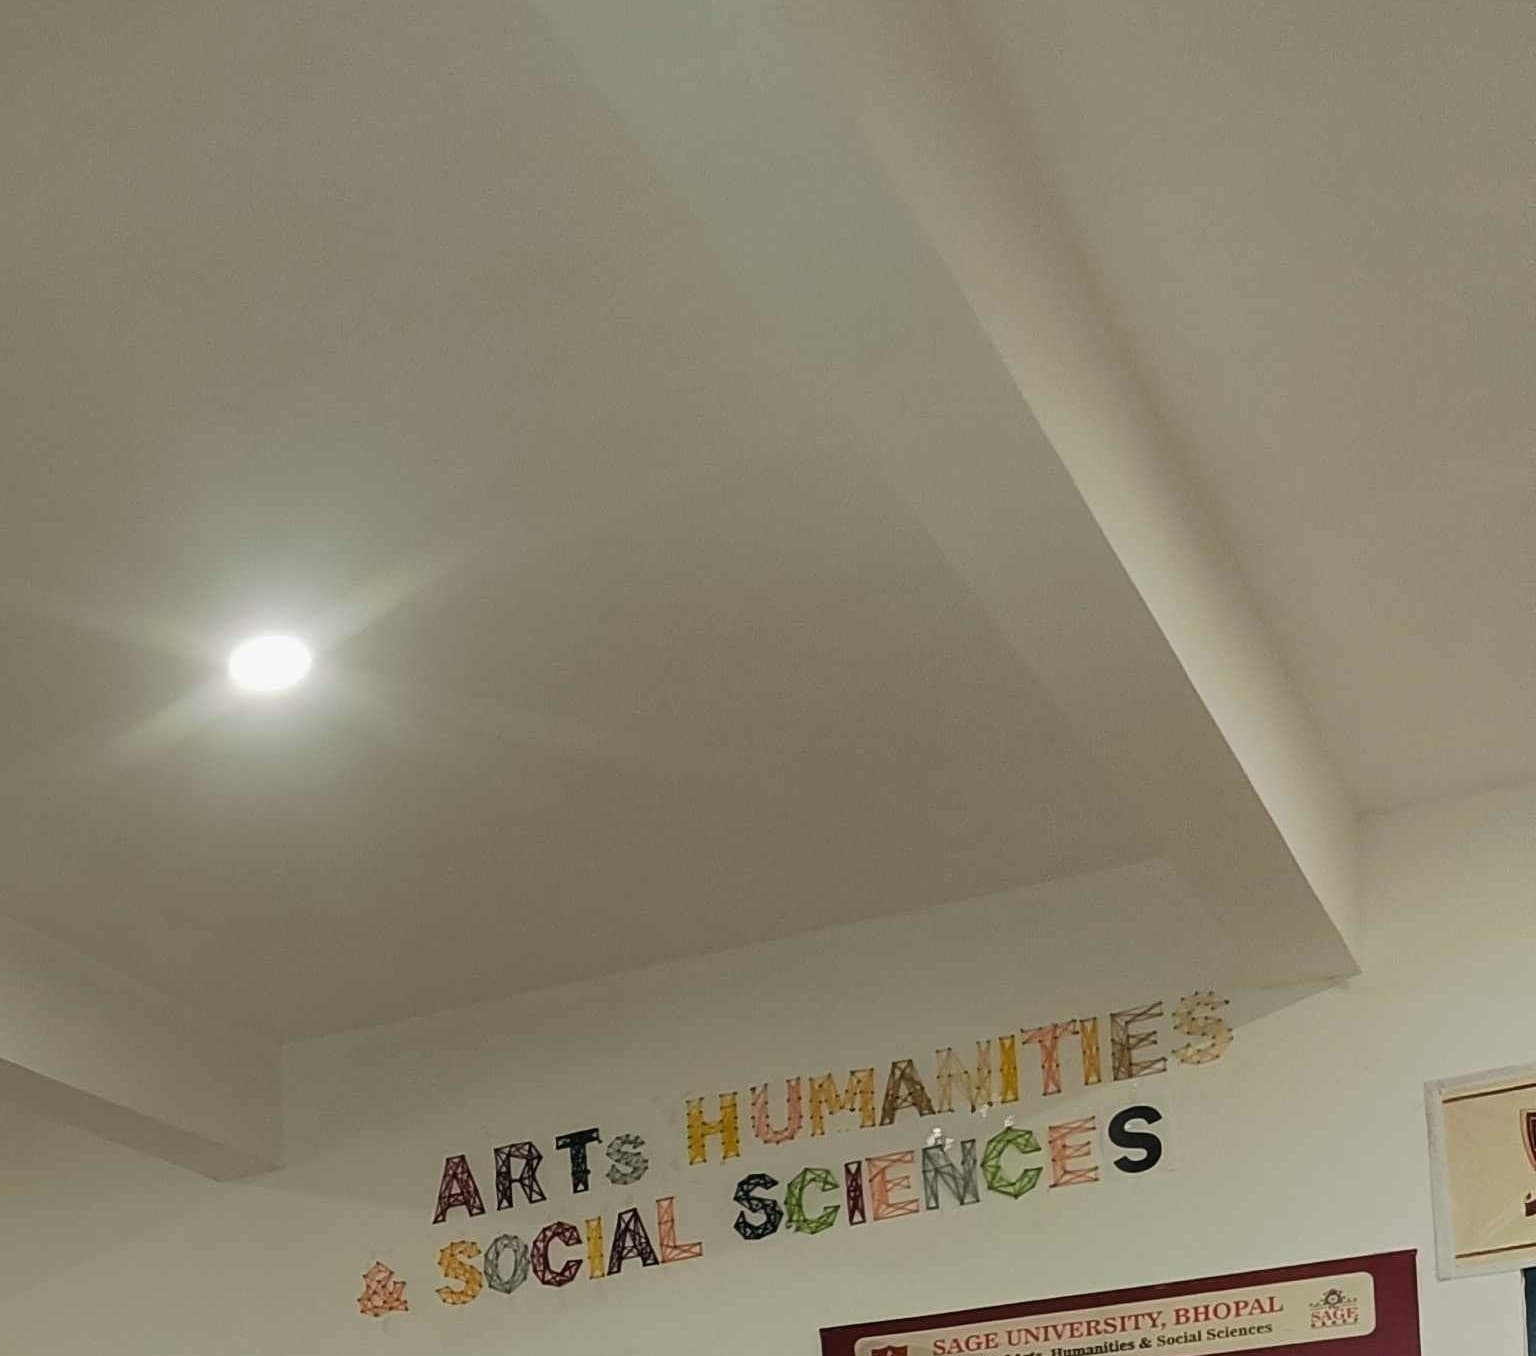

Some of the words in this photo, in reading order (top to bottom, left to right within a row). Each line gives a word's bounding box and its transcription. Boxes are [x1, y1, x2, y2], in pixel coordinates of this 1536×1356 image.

[432, 1128, 649, 1224] ARTS
[684, 990, 1234, 1167] HUMANITIES
[358, 1261, 411, 1317] &
[435, 1196, 703, 1306] SOCIAL
[732, 1105, 1163, 1240] SCIENCES
[932, 1332, 999, 1356] SAGE
[1006, 1310, 1166, 1346] UNIVERSITY,
[1174, 1296, 1283, 1325] BHOPAL
[1139, 1336, 1152, 1349] &
[1157, 1330, 1201, 1347] Social
[1206, 1324, 1272, 1340] Sciences
